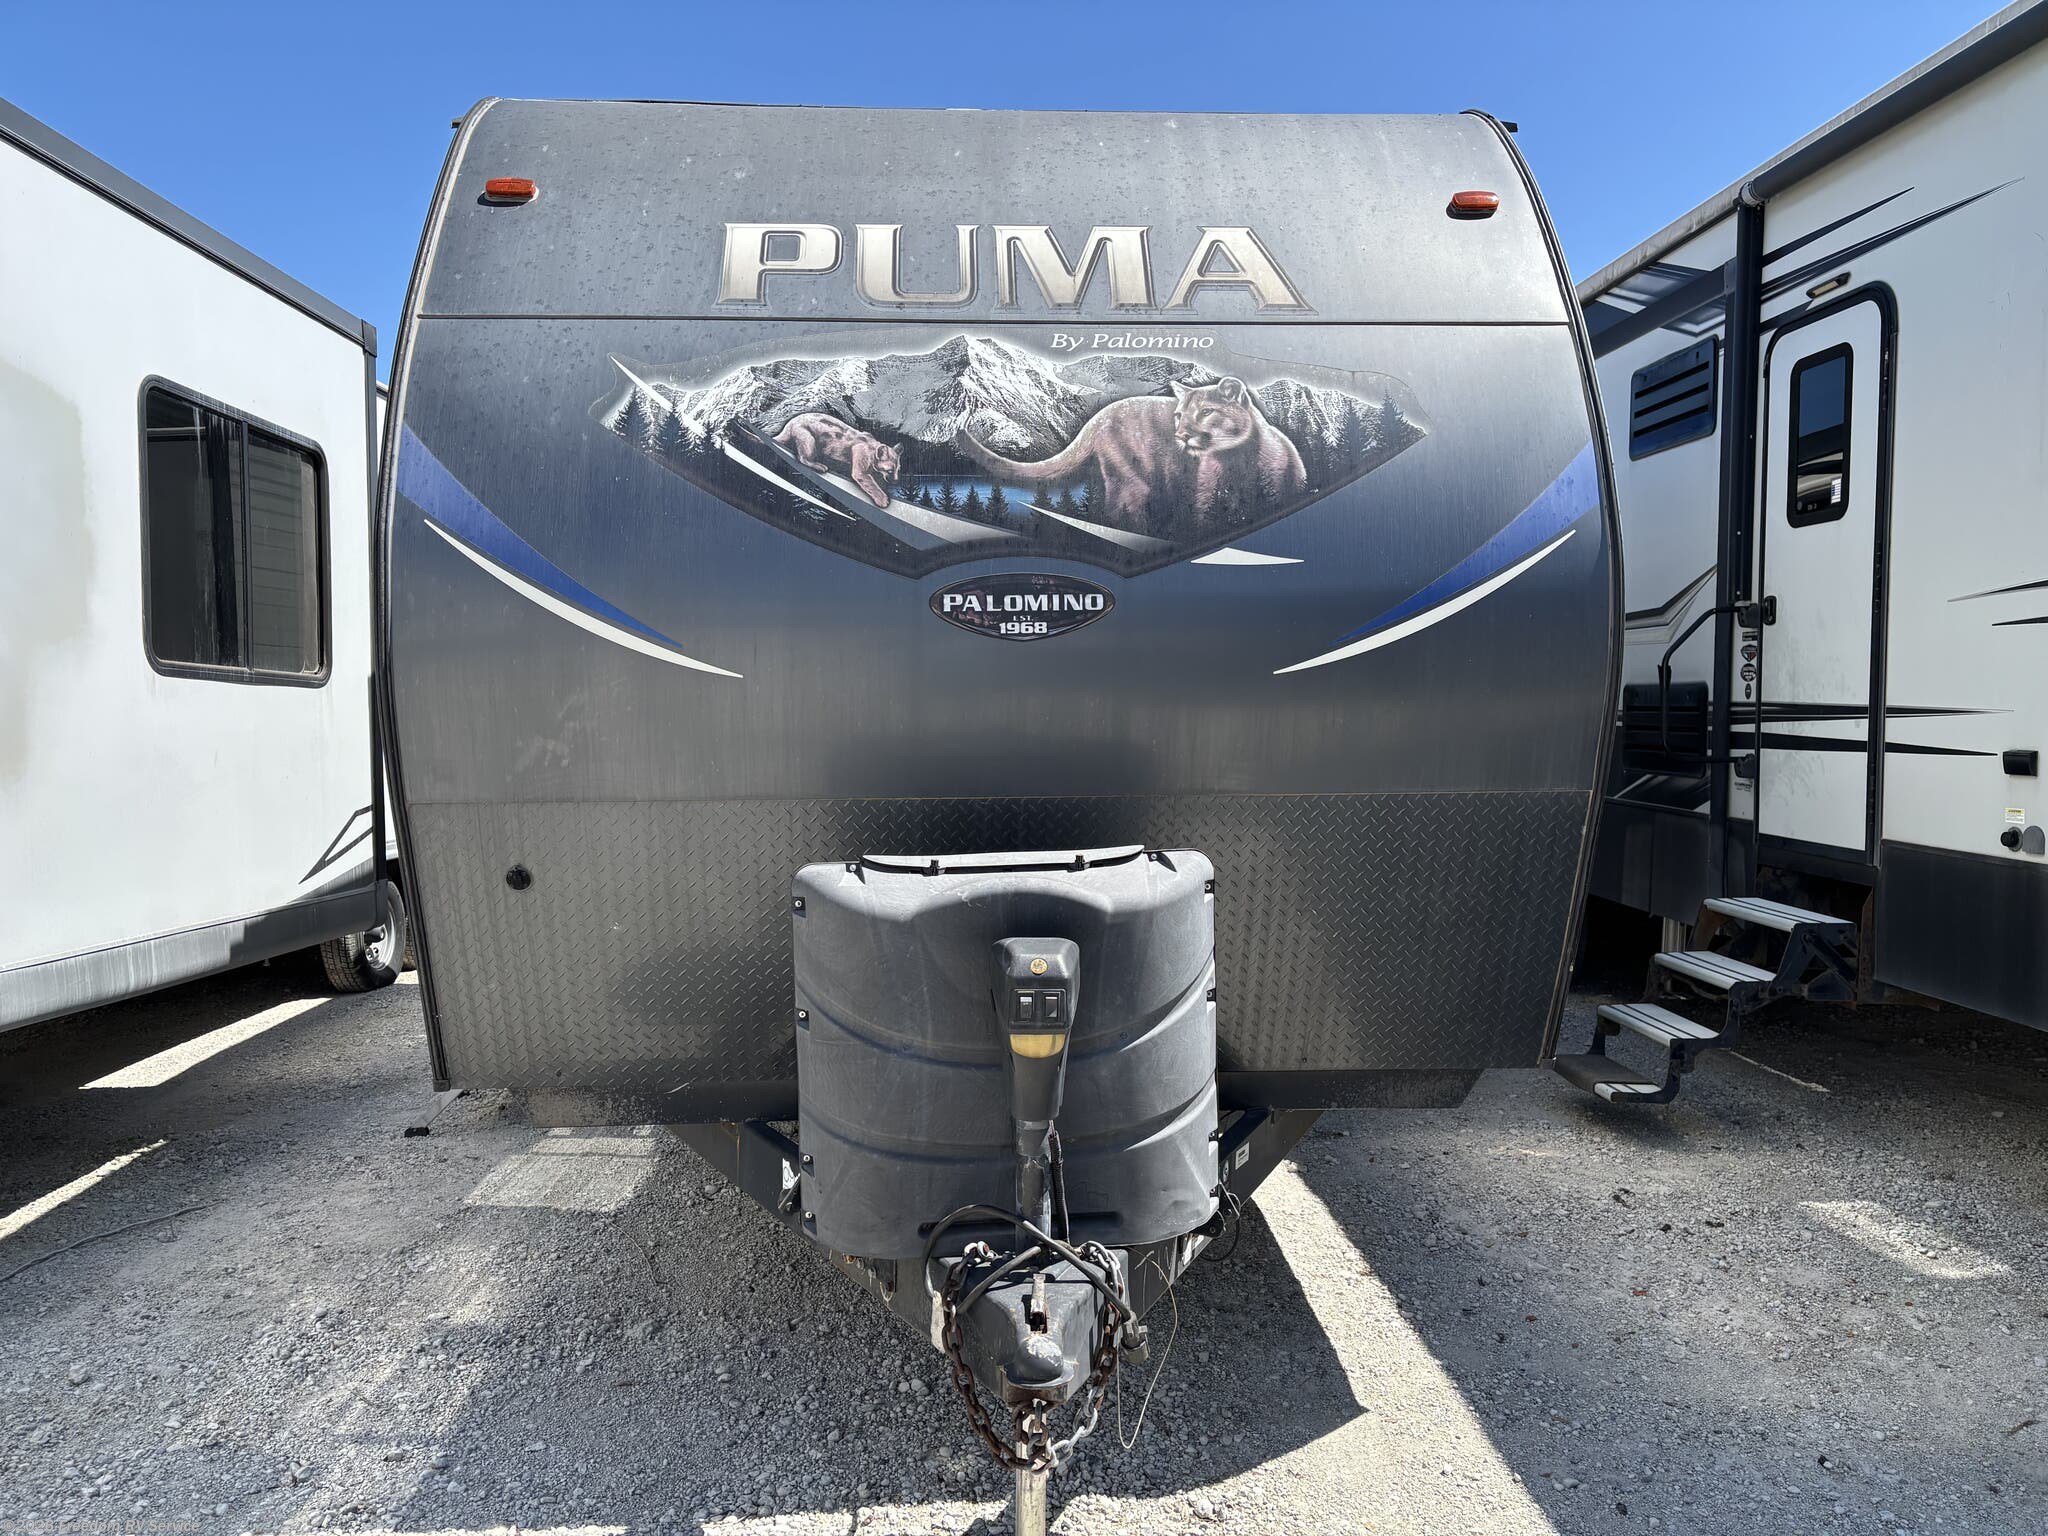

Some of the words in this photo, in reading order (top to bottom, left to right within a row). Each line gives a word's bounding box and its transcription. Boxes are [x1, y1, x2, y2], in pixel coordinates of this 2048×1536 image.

[717, 222, 1317, 312] PUMA
[1051, 333, 1085, 352] By
[1092, 333, 1214, 349] Palomino
[943, 593, 1104, 612] PALOMINO
[999, 621, 1048, 634] 1968
